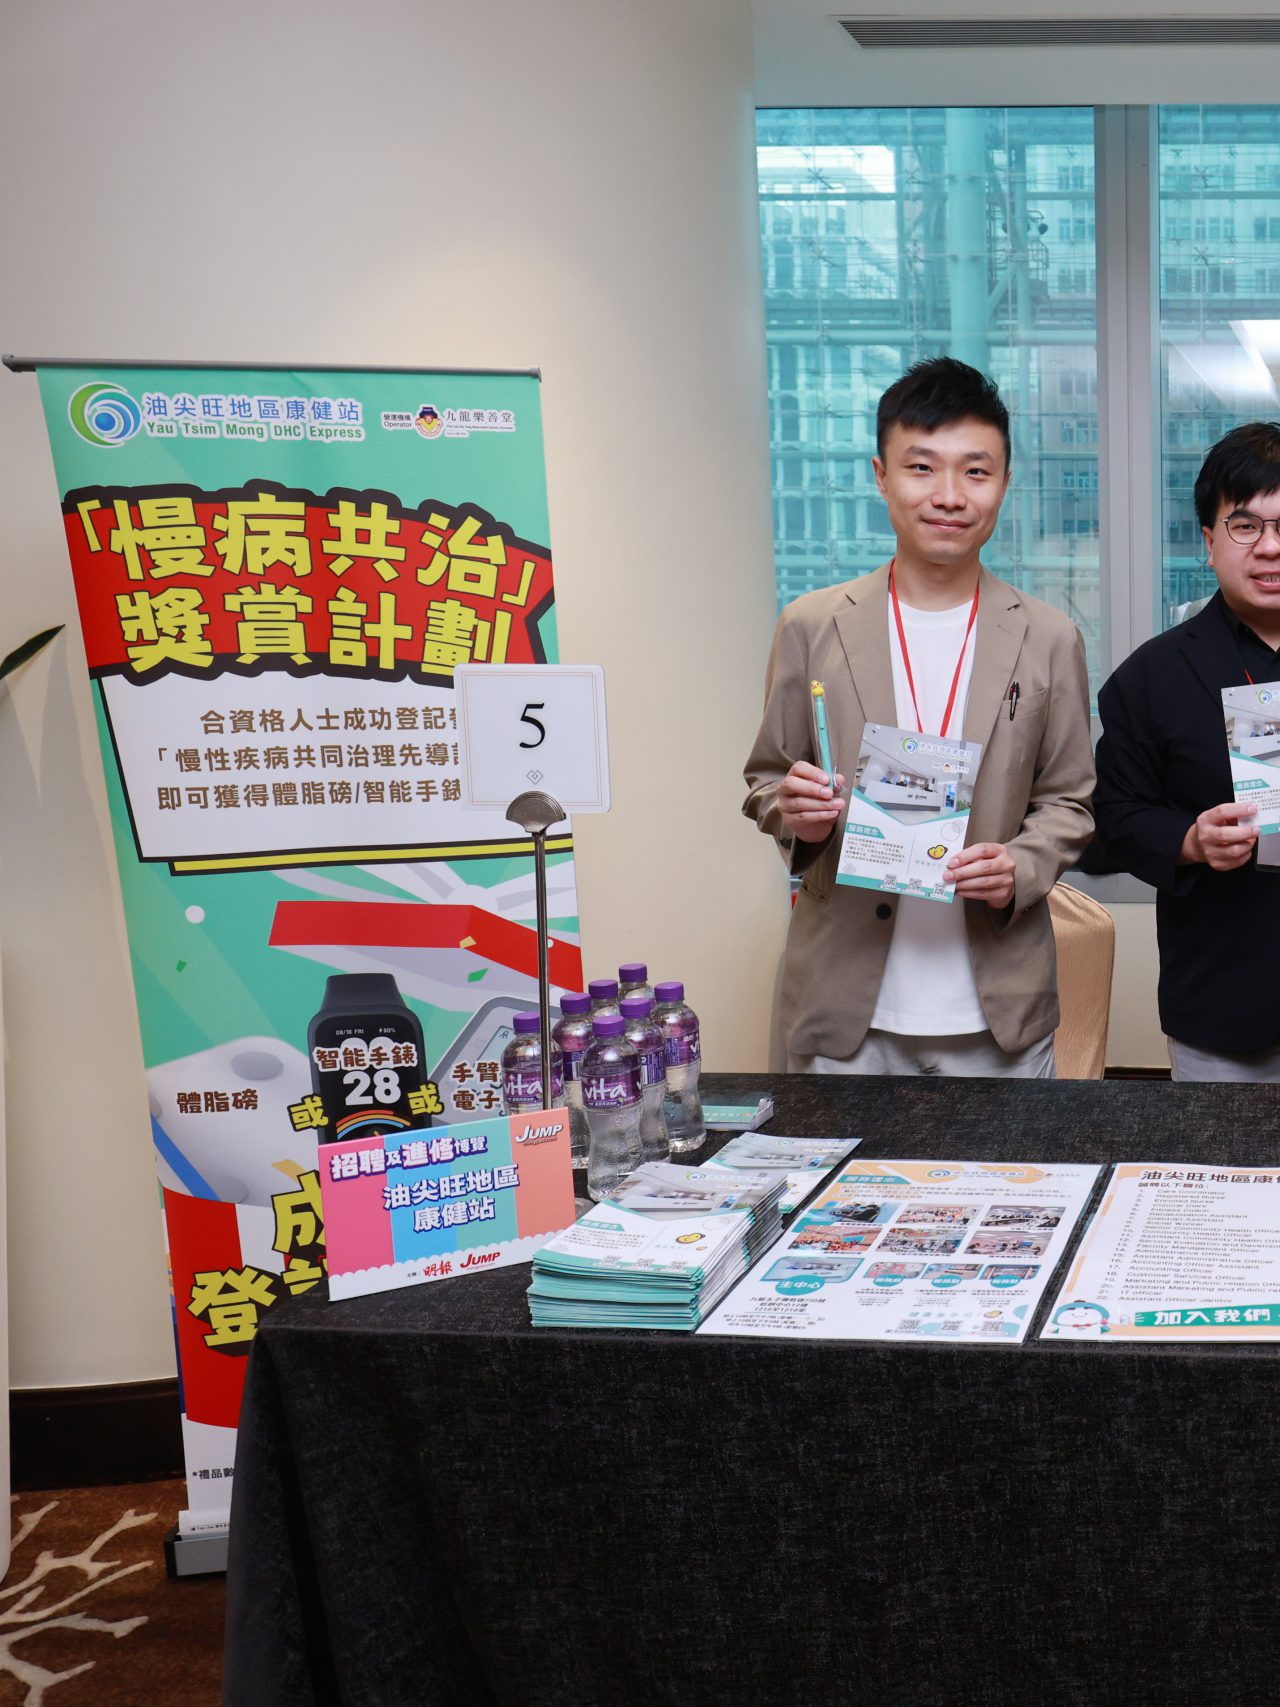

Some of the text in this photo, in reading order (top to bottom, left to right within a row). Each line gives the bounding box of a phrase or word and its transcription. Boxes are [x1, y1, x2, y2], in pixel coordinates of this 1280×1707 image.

[145, 396, 361, 421] 油尖旺地區康健站
[446, 410, 512, 423] 九龍樂善堂
[147, 422, 362, 440] Yau Tsim Mong DHC Express
[384, 421, 412, 429] Operator
[77, 492, 535, 608] 「慢病共治」
[115, 583, 512, 676] 獎賞計劃
[519, 702, 546, 749] 5
[316, 1044, 415, 1070] 智能手錶
[453, 1062, 499, 1084] 手臂
[343, 1069, 401, 1106] 28
[408, 1084, 442, 1116] 或
[453, 1089, 499, 1111] 電子
[584, 1077, 627, 1100] vita
[177, 1088, 258, 1114] 體脂磅
[290, 1096, 329, 1130] 或
[515, 1124, 563, 1143] JUMP
[331, 1136, 487, 1179] 招聘及進修博覽
[383, 1164, 519, 1209] 油尖旺地區
[414, 1197, 495, 1232] 康健站
[423, 1260, 453, 1277] 明報
[460, 1251, 501, 1269] JUMP
[778, 1280, 822, 1290] 主中心
[1153, 1308, 1271, 1326] 加入我們
